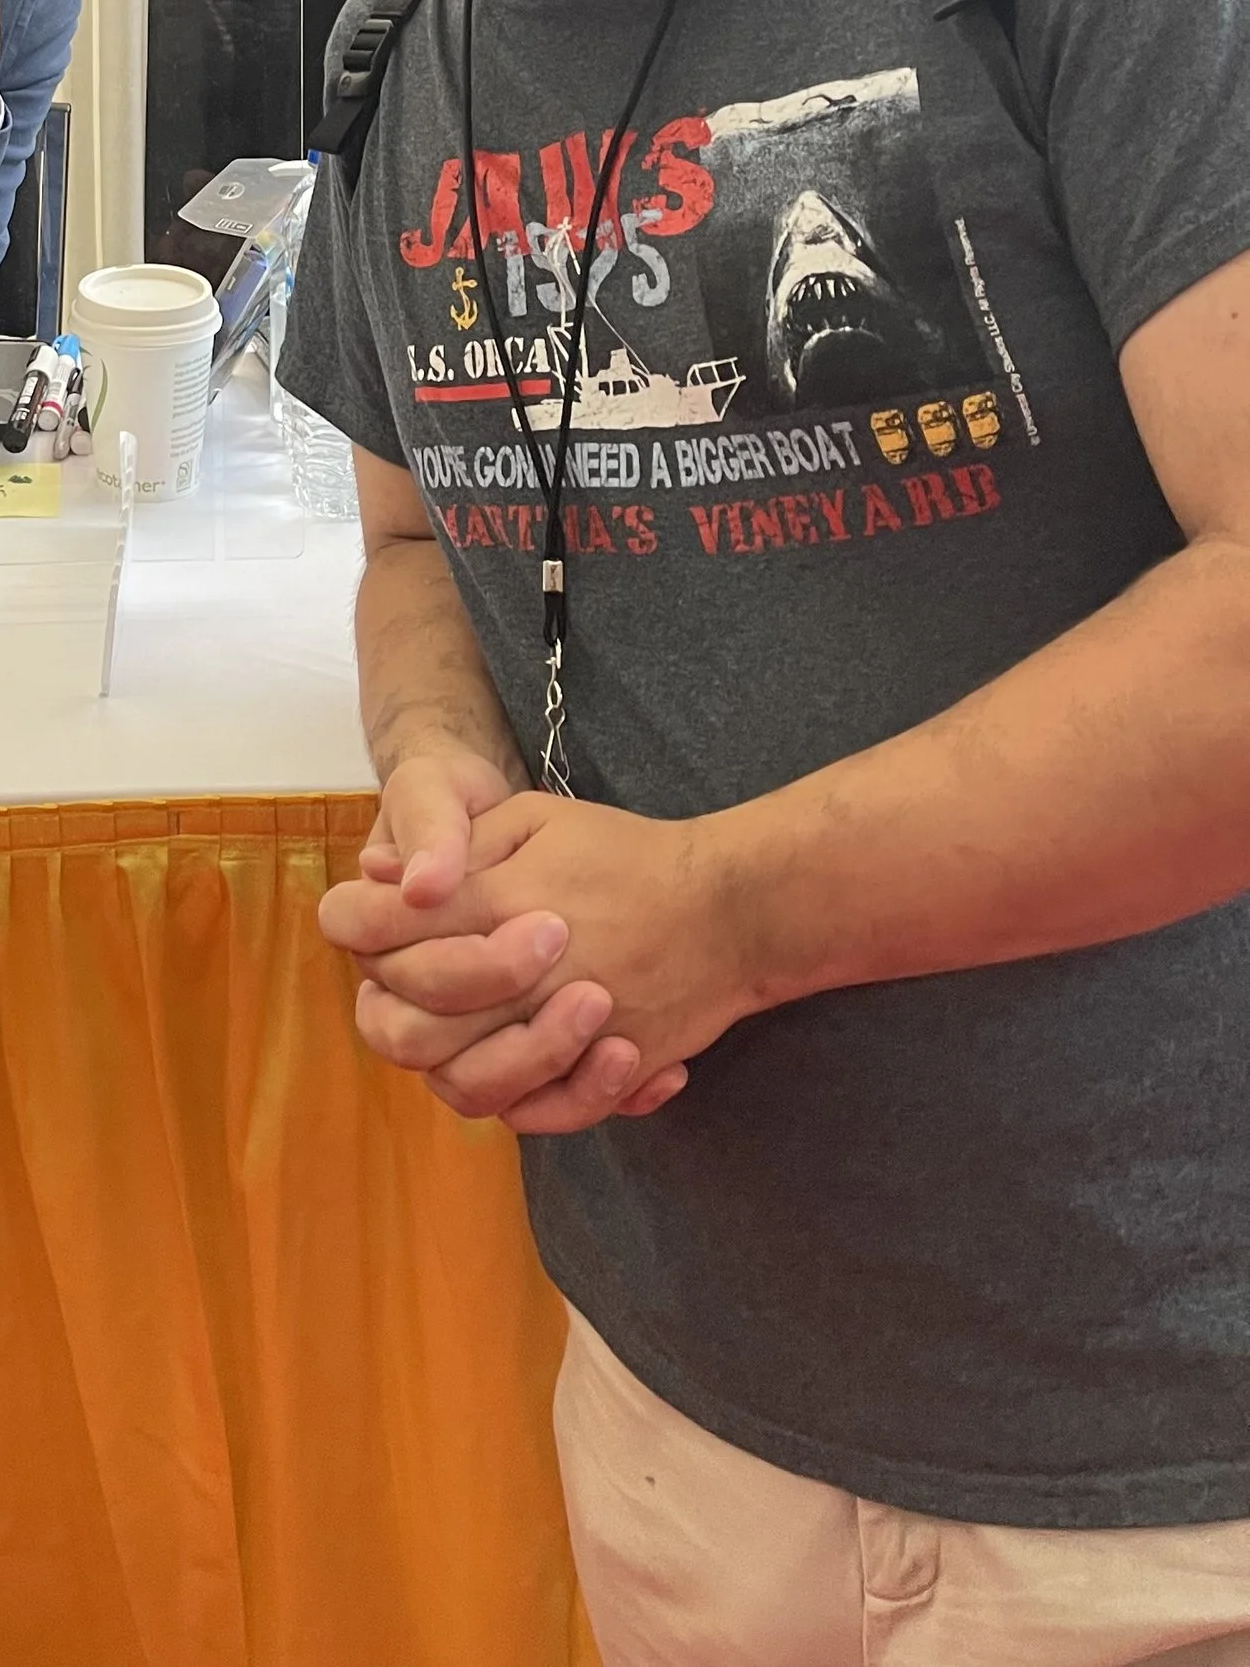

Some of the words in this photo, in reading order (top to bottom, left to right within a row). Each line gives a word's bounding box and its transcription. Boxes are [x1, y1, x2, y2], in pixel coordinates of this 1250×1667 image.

[400, 116, 715, 269] JAWS
[463, 336, 552, 380] ORCA
[95, 467, 161, 493] ecotner
[473, 444, 567, 489] GONN
[565, 441, 641, 488] NEED
[650, 441, 673, 489] A
[674, 433, 777, 488] BIGGER
[767, 420, 862, 476] BOAT
[688, 462, 1002, 556] VINEYARD
